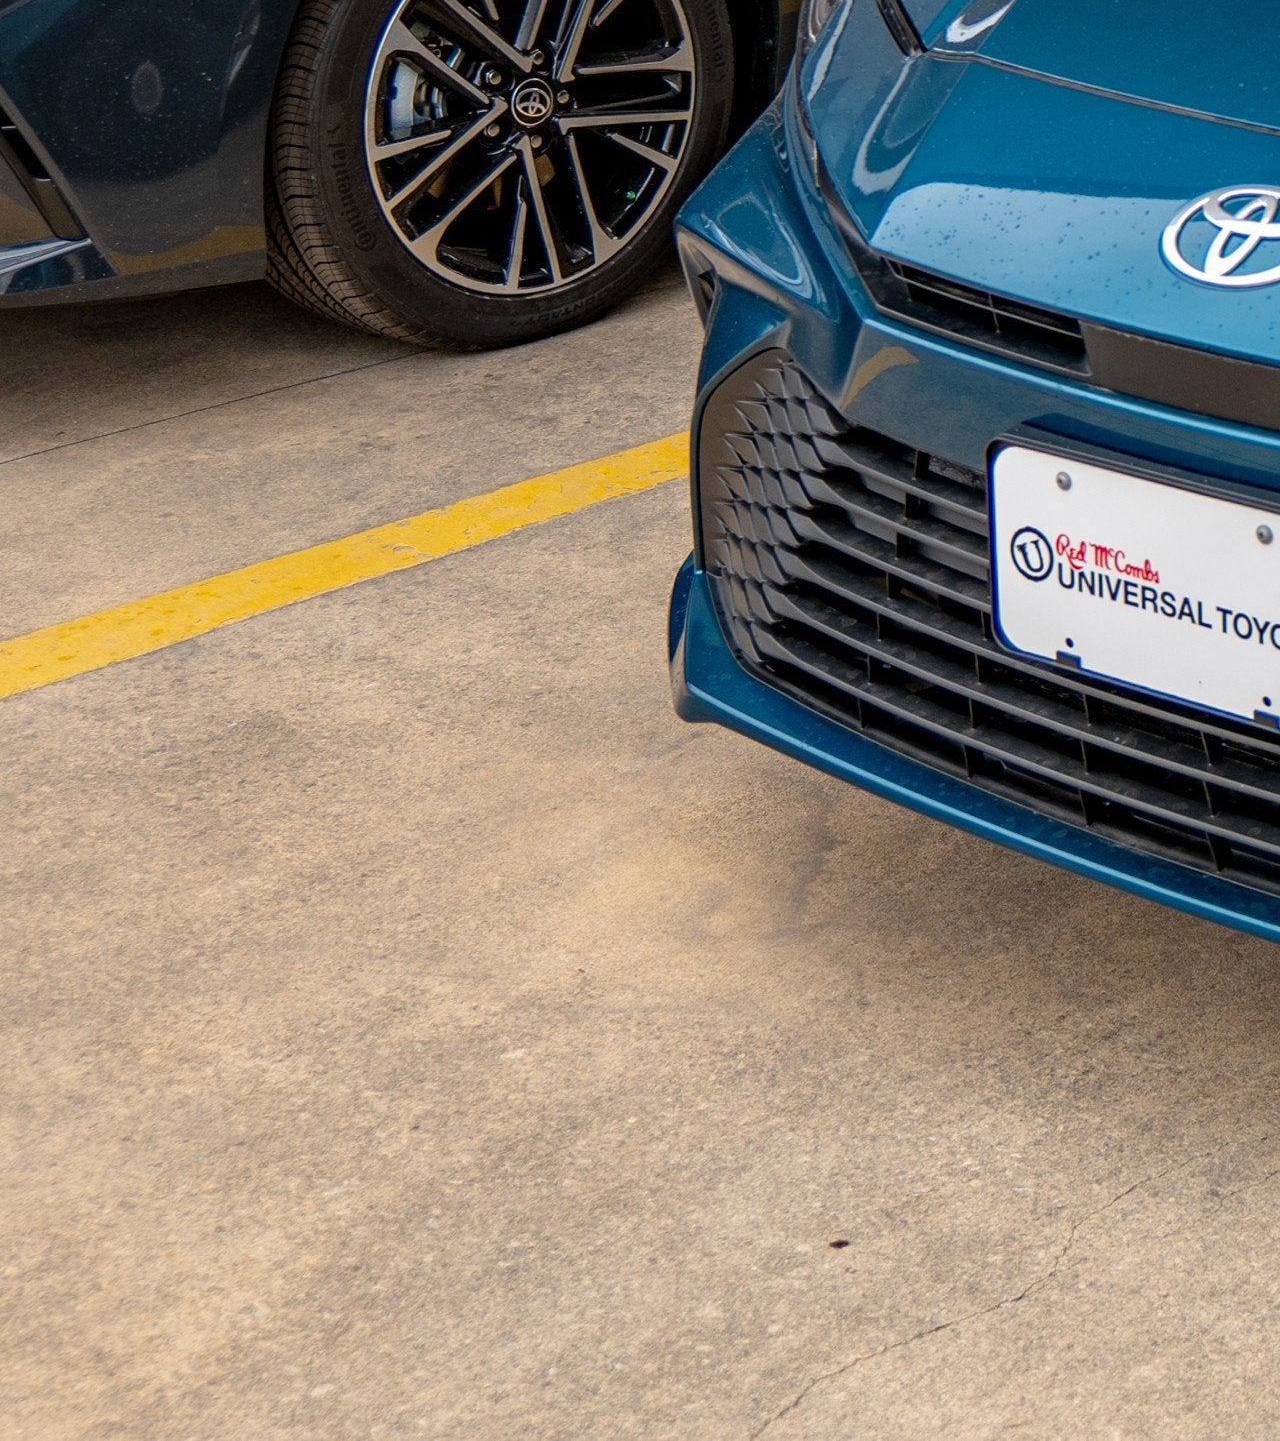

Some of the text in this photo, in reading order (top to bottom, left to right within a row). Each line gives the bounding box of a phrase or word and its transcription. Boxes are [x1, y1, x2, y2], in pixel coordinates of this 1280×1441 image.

[327, 143, 377, 252] Continental
[1055, 534, 1160, 585] Red McCombs
[1057, 562, 1213, 629] UNIVERSAL
